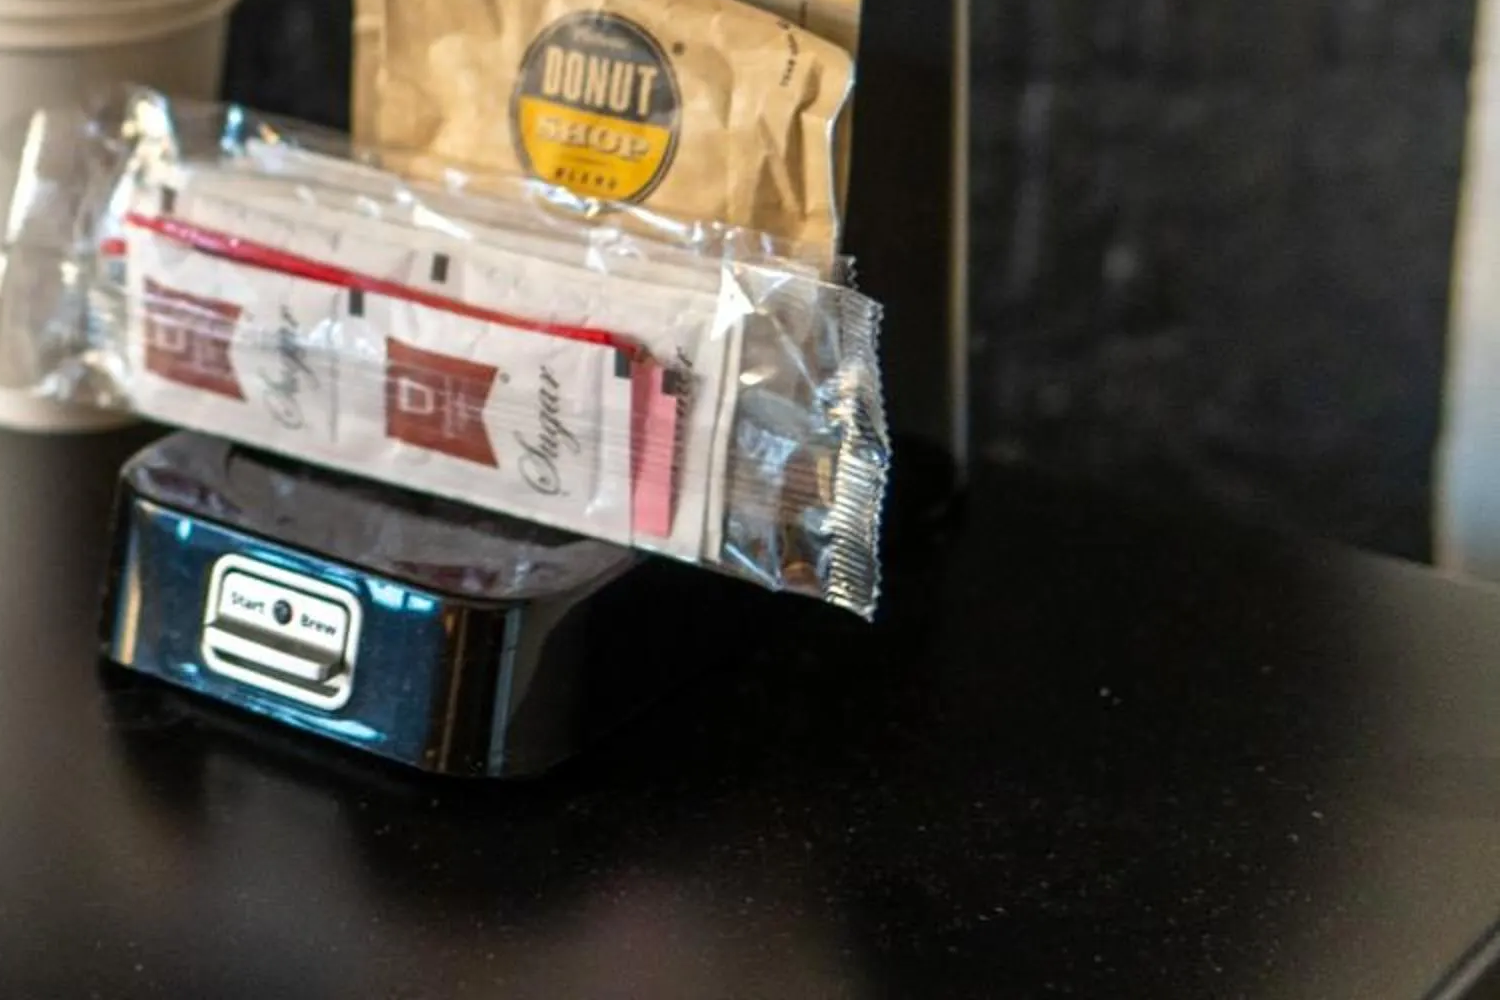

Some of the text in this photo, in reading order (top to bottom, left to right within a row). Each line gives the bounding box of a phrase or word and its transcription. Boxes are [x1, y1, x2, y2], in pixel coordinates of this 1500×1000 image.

[543, 45, 658, 117] DONUT
[537, 115, 649, 160] SHOP
[512, 364, 581, 496] Sugar
[231, 591, 337, 638] Start Brew
